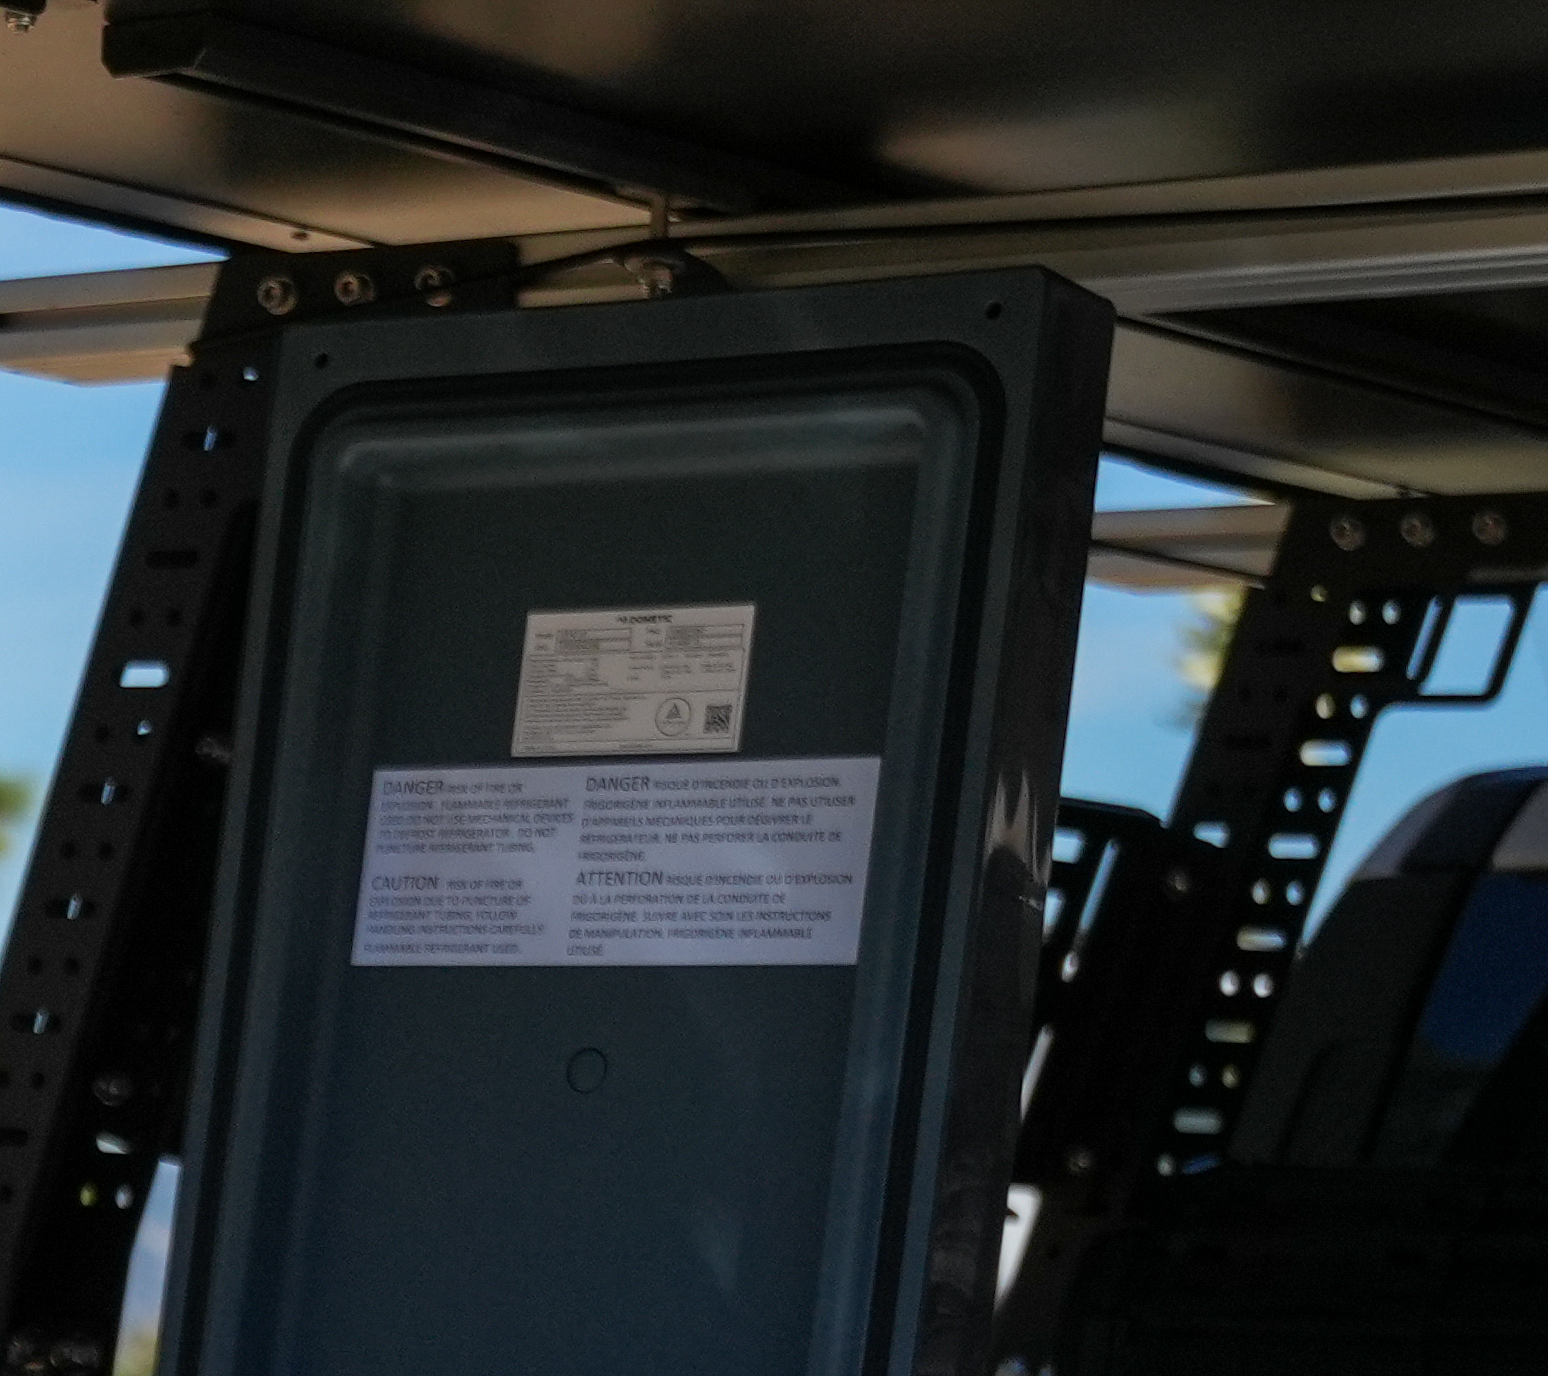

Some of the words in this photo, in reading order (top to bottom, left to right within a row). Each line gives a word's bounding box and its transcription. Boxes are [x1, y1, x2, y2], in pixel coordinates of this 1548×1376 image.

[383, 780, 444, 795] DANGER
[585, 775, 650, 792] DANGER
[372, 876, 440, 890] CAUTION
[576, 870, 663, 887] ATTENTION
